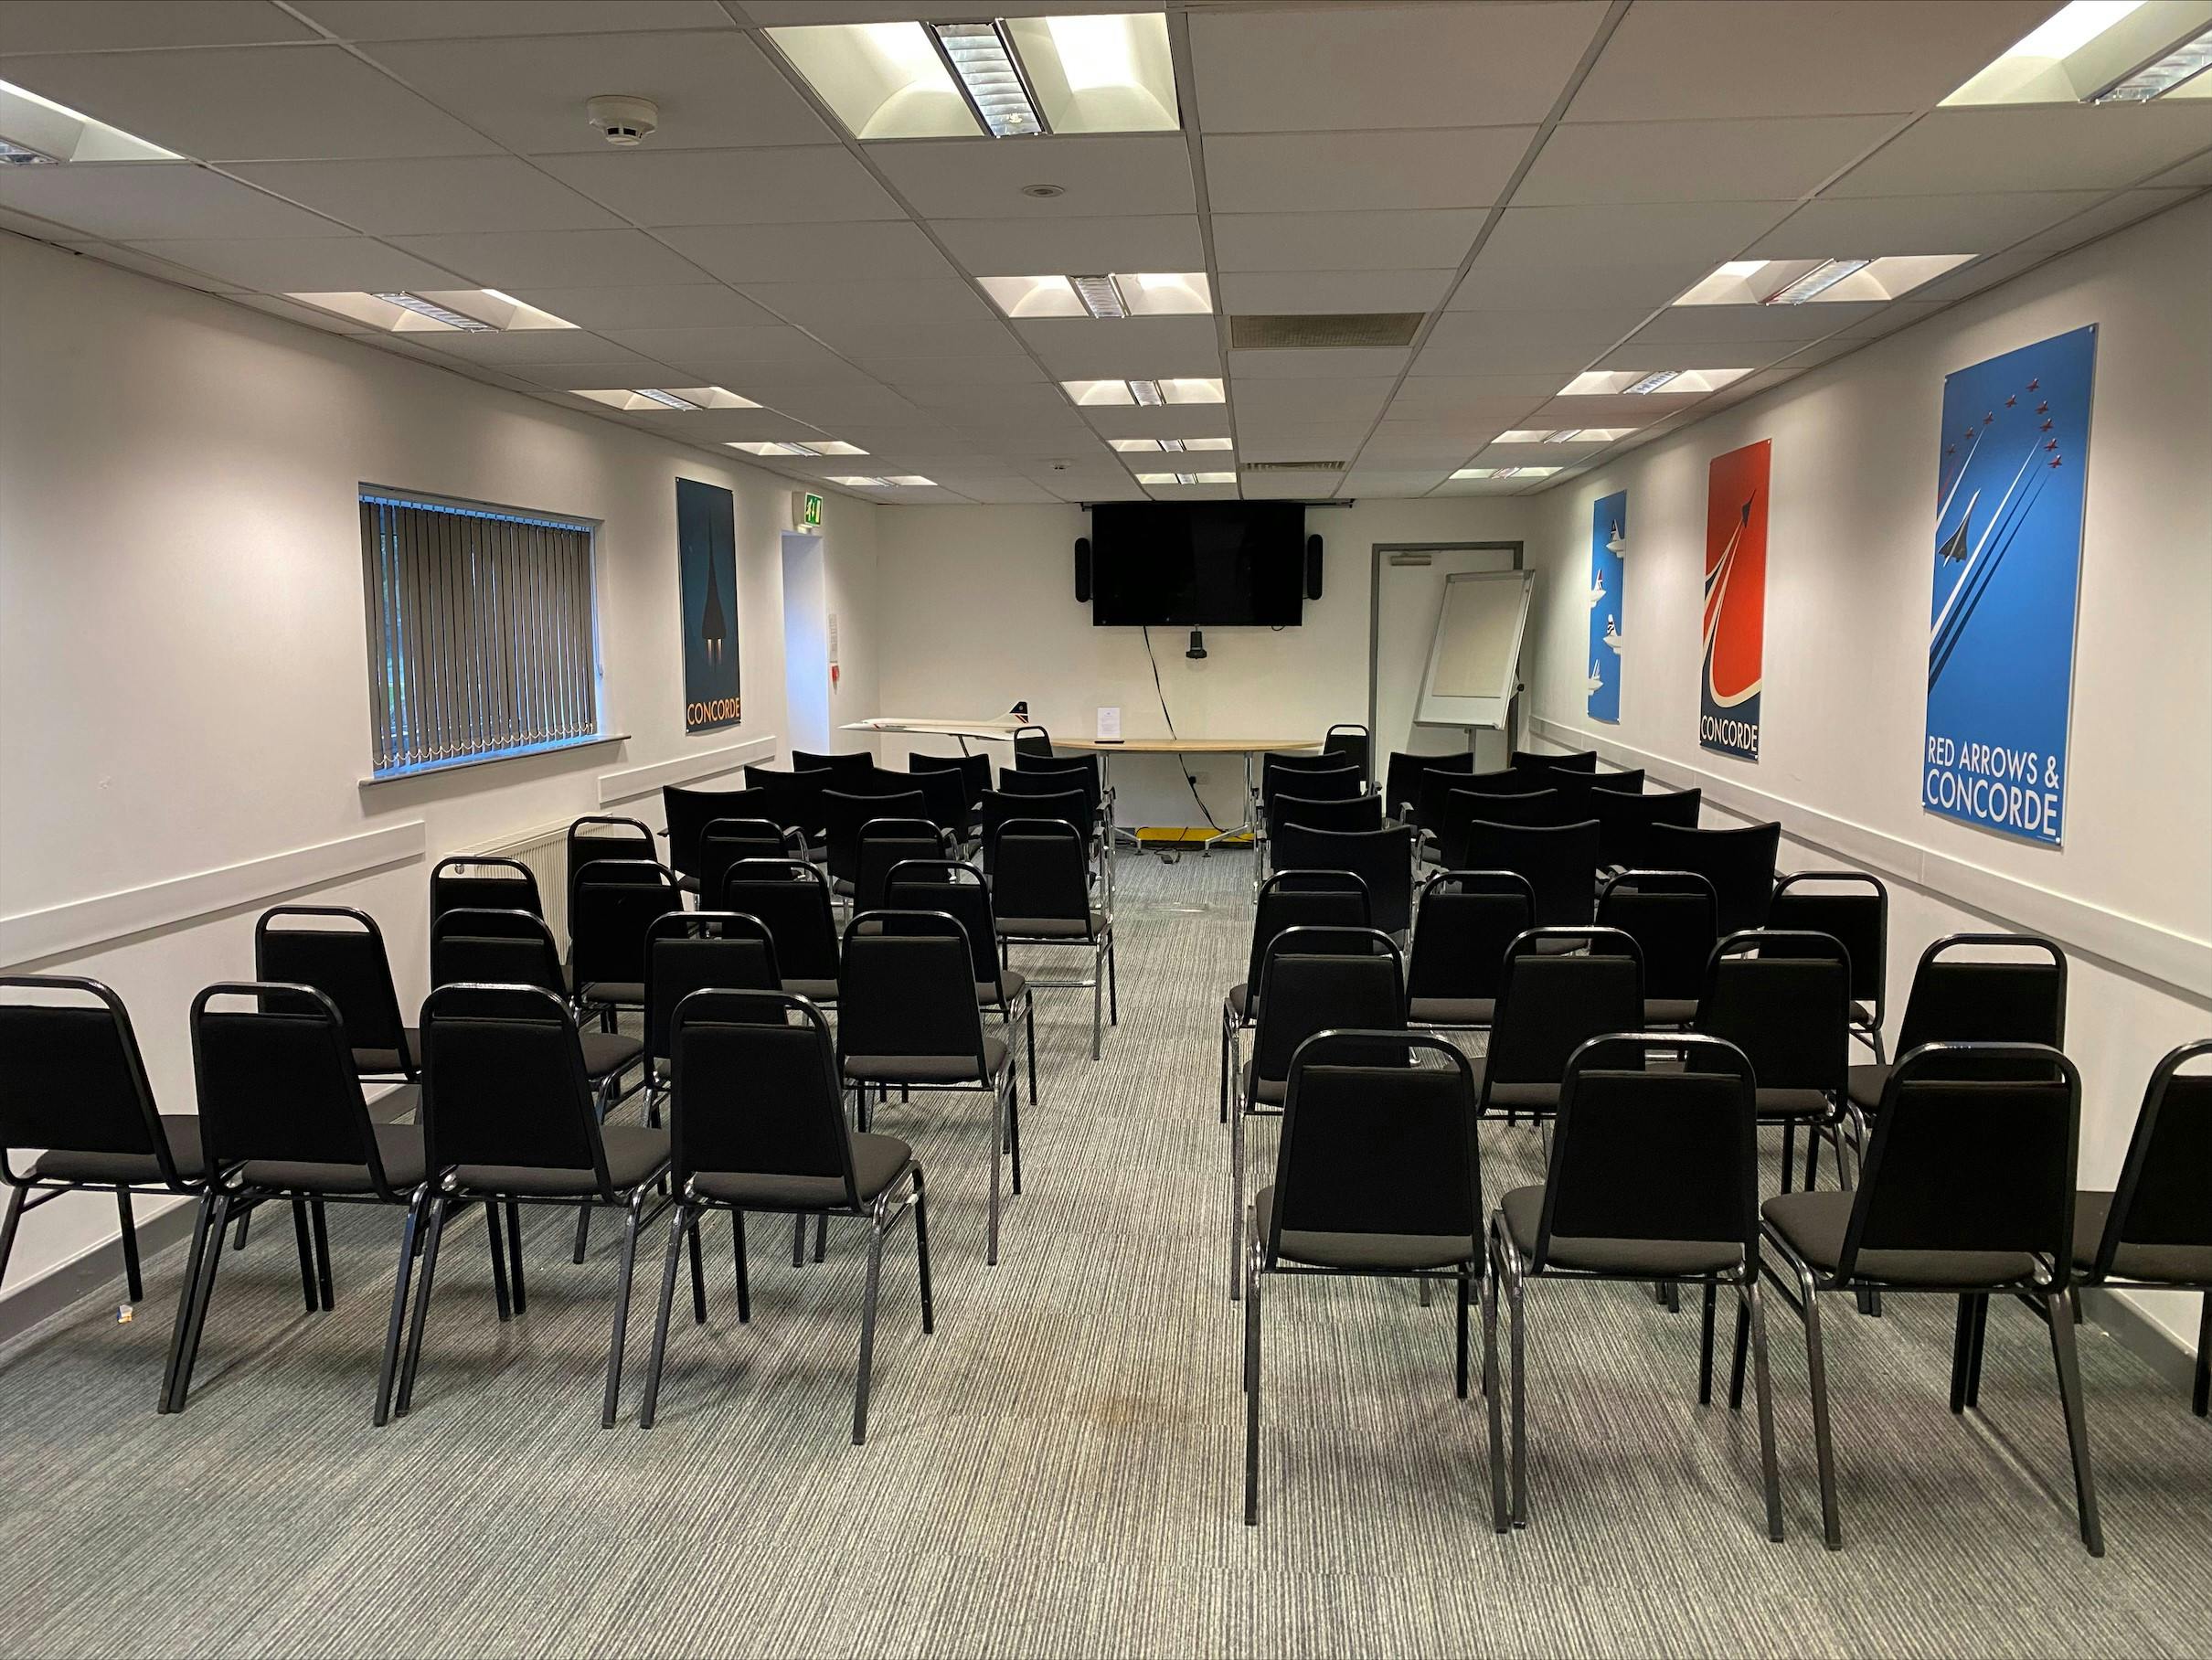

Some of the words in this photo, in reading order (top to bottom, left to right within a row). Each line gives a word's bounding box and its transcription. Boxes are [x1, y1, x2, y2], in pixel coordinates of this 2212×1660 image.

[687, 697, 739, 725] CONCORDE
[1701, 715, 1758, 751] CONCORDE
[1928, 735, 1955, 767] RED
[1959, 741, 2038, 784] ARROWS
[2044, 756, 2059, 789] &
[1926, 769, 2058, 836] CONCORDE
